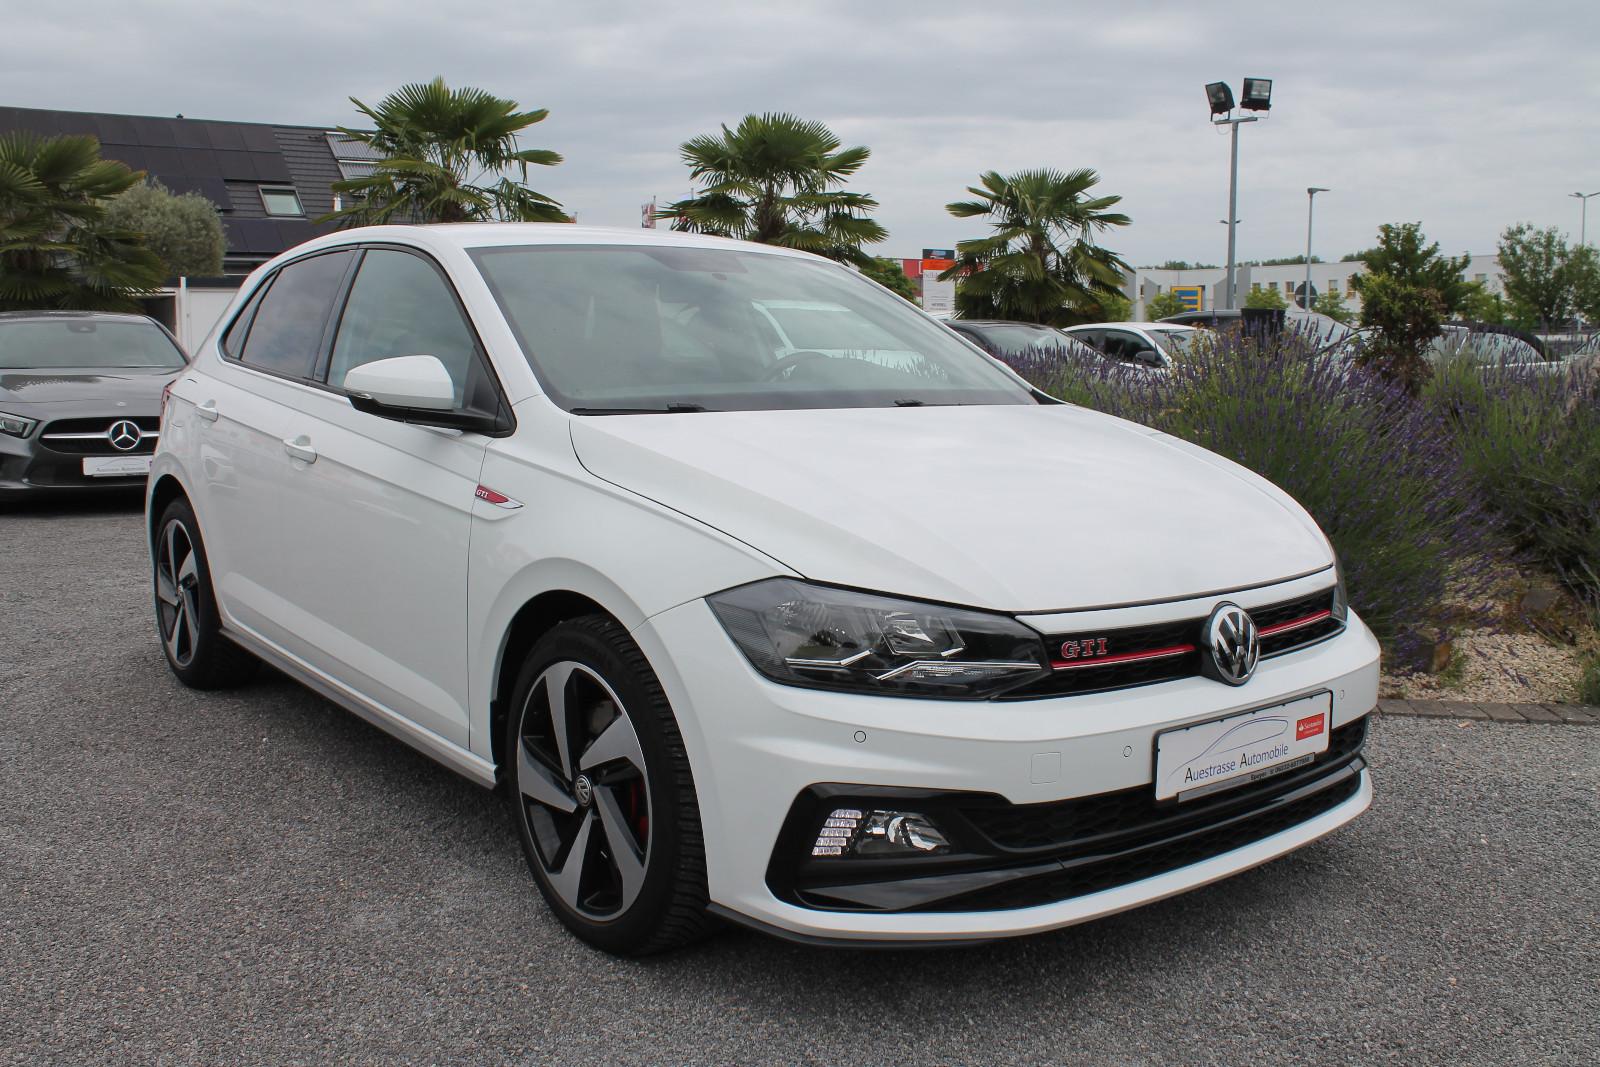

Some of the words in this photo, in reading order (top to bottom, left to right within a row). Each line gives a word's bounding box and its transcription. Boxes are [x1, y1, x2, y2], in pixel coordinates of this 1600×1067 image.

[476, 489, 489, 499] GTI
[1061, 638, 1107, 659] GTI
[1184, 760, 1236, 783] Auestrasse
[1239, 743, 1289, 768] Automobile
